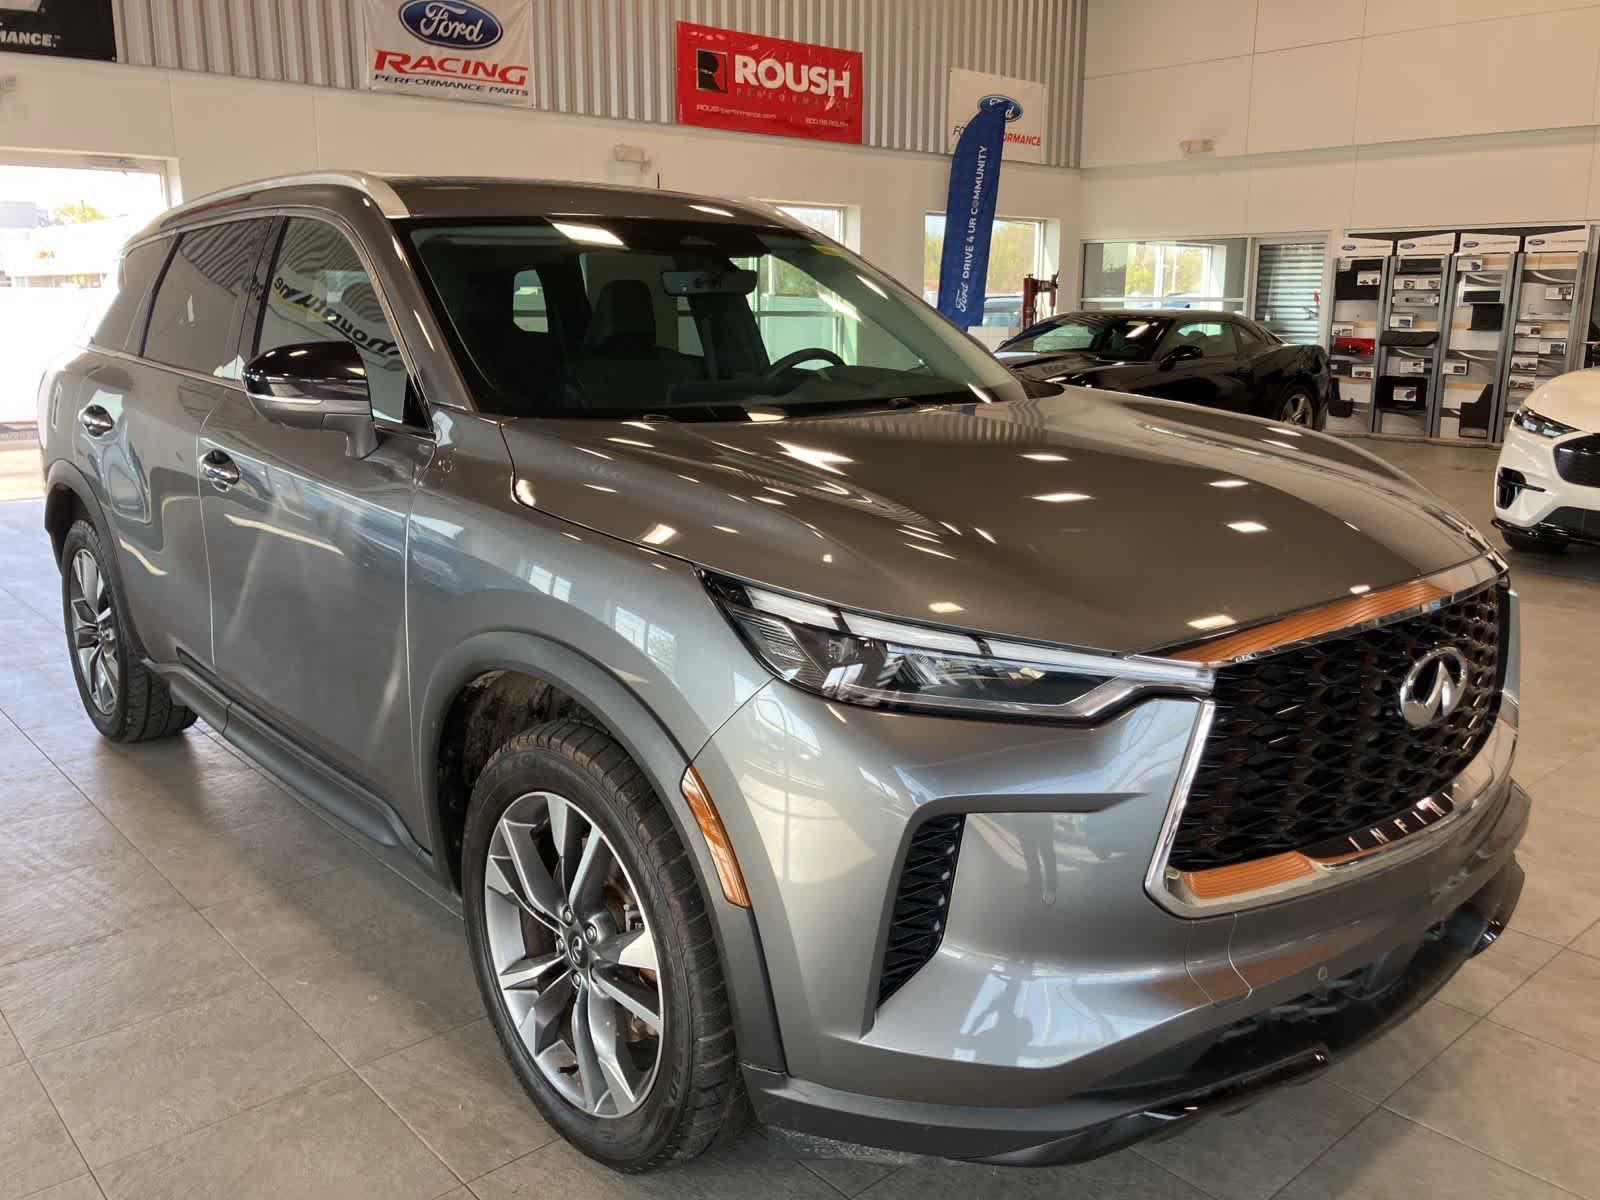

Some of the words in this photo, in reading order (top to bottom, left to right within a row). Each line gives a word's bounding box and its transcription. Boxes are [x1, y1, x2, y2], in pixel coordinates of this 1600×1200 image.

[420, 1, 483, 43] Ford
[374, 50, 529, 85] RACING
[734, 54, 850, 98] ROUSH
[374, 74, 485, 91] PERFORMANCE
[488, 86, 529, 97] PARTS
[971, 145, 989, 215] COMMUNITY
[968, 217, 977, 234] UR
[962, 244, 974, 279] DRIVE
[954, 282, 969, 313] Ford
